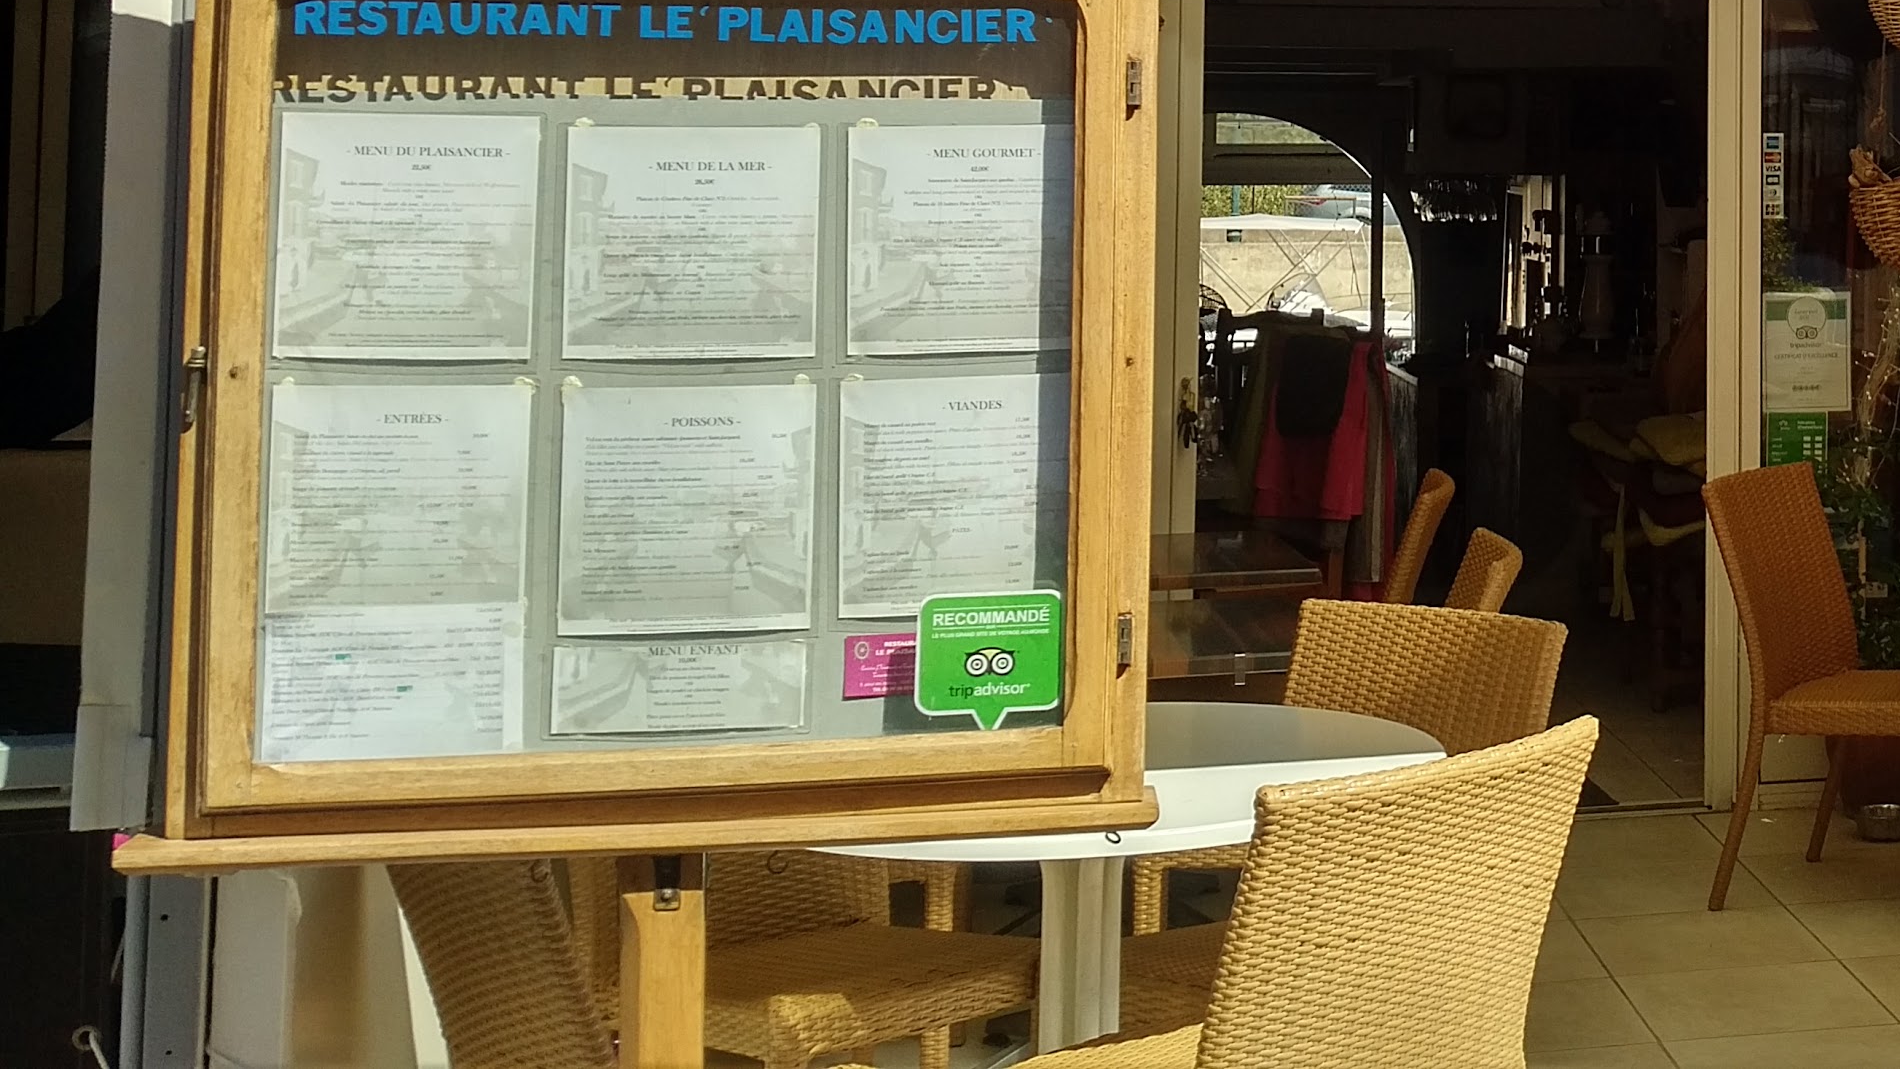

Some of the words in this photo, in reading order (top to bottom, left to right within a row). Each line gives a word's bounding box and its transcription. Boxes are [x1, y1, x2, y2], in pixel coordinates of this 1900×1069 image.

[294, 0, 621, 37] RESTAURANT
[354, 146, 391, 156] MENU
[397, 146, 416, 156] DU
[419, 147, 503, 157] PLAISANCIER
[933, 148, 970, 158] MENU
[973, 147, 1036, 158] GOURMET
[656, 162, 693, 171] MENU
[697, 162, 715, 171] DE
[718, 162, 734, 171] LA
[738, 161, 766, 171] MER
[949, 400, 1002, 411] VIANDES
[383, 413, 442, 424] ENTRÉES
[671, 416, 734, 427] POISSONS
[932, 606, 1050, 627] RECOMMANDÉ
[648, 646, 687, 656] MENU
[690, 644, 742, 656] ENFANT
[948, 682, 1030, 700] tripadvisor
